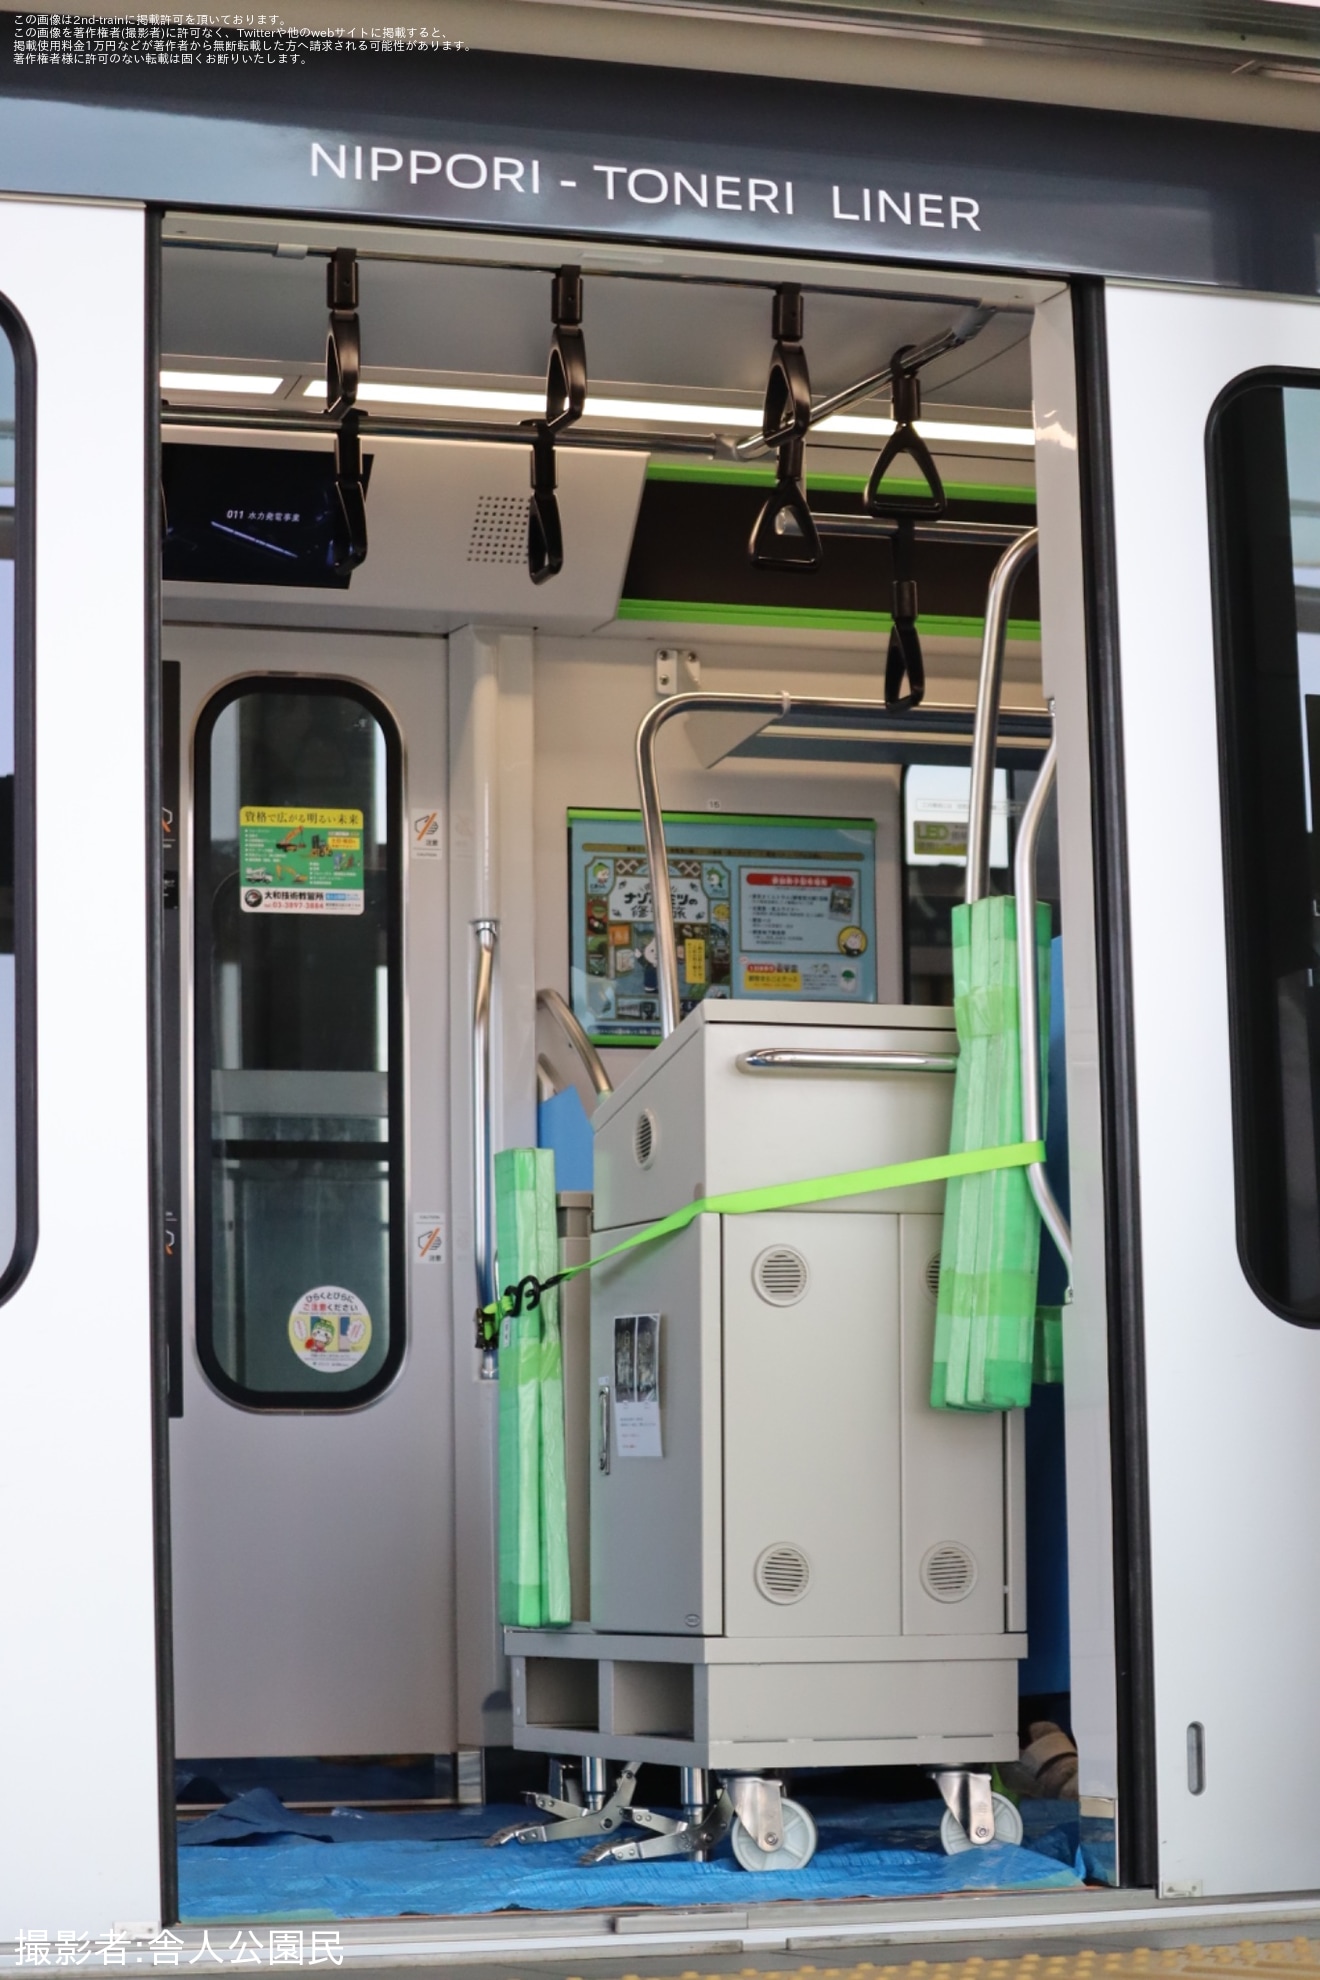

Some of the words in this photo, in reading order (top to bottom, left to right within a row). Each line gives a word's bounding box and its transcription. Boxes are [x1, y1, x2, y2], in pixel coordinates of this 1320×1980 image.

[310, 142, 541, 194] NIPPORI
[593, 165, 794, 215] TONERI
[832, 185, 981, 232] LINER
[227, 510, 244, 519] 011
[244, 810, 359, 825] 資格で広がる明るい未来
[306, 1291, 355, 1303] ひらくとびらに
[303, 1303, 358, 1312] ご注意ください
